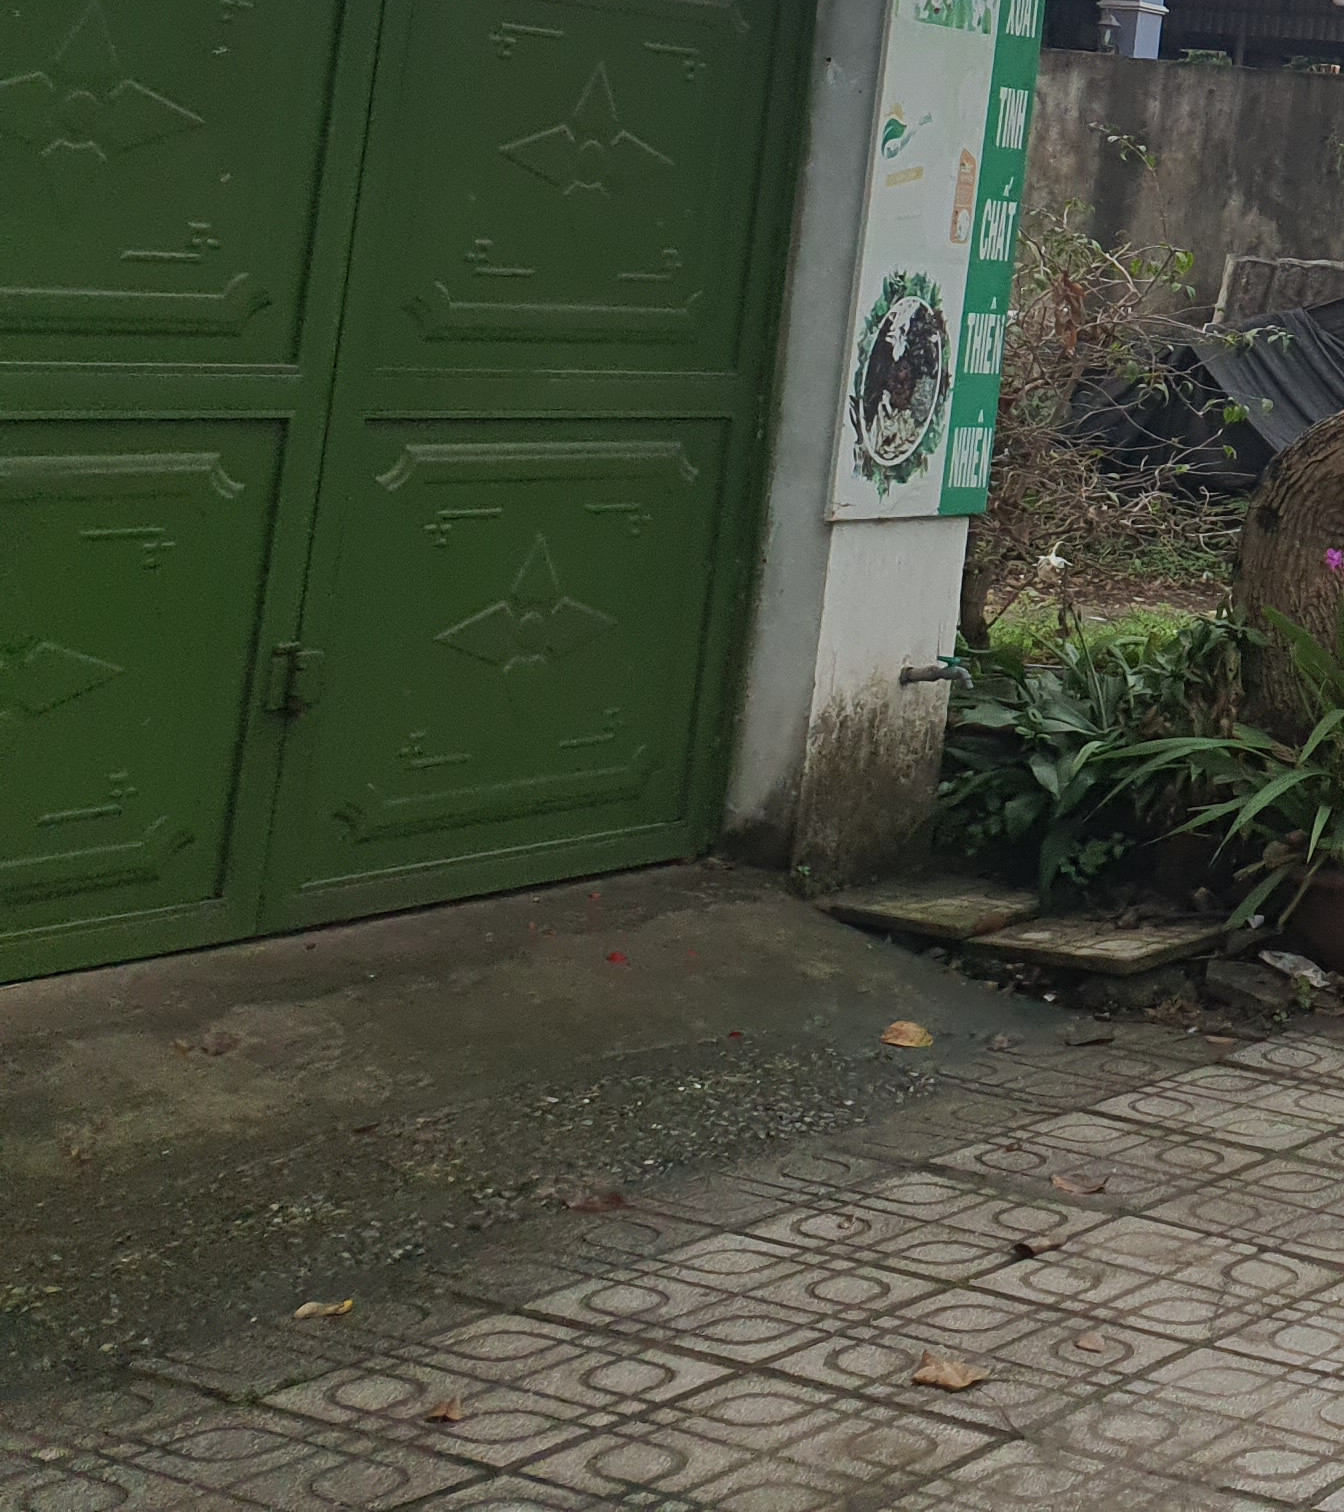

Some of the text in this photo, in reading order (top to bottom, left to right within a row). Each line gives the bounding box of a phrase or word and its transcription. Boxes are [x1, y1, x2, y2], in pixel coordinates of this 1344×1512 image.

[996, 87, 1028, 149] TINH
[979, 176, 1017, 262] CHẤT
[964, 296, 1006, 374] THIÊN
[948, 409, 993, 488] NHIÊN
